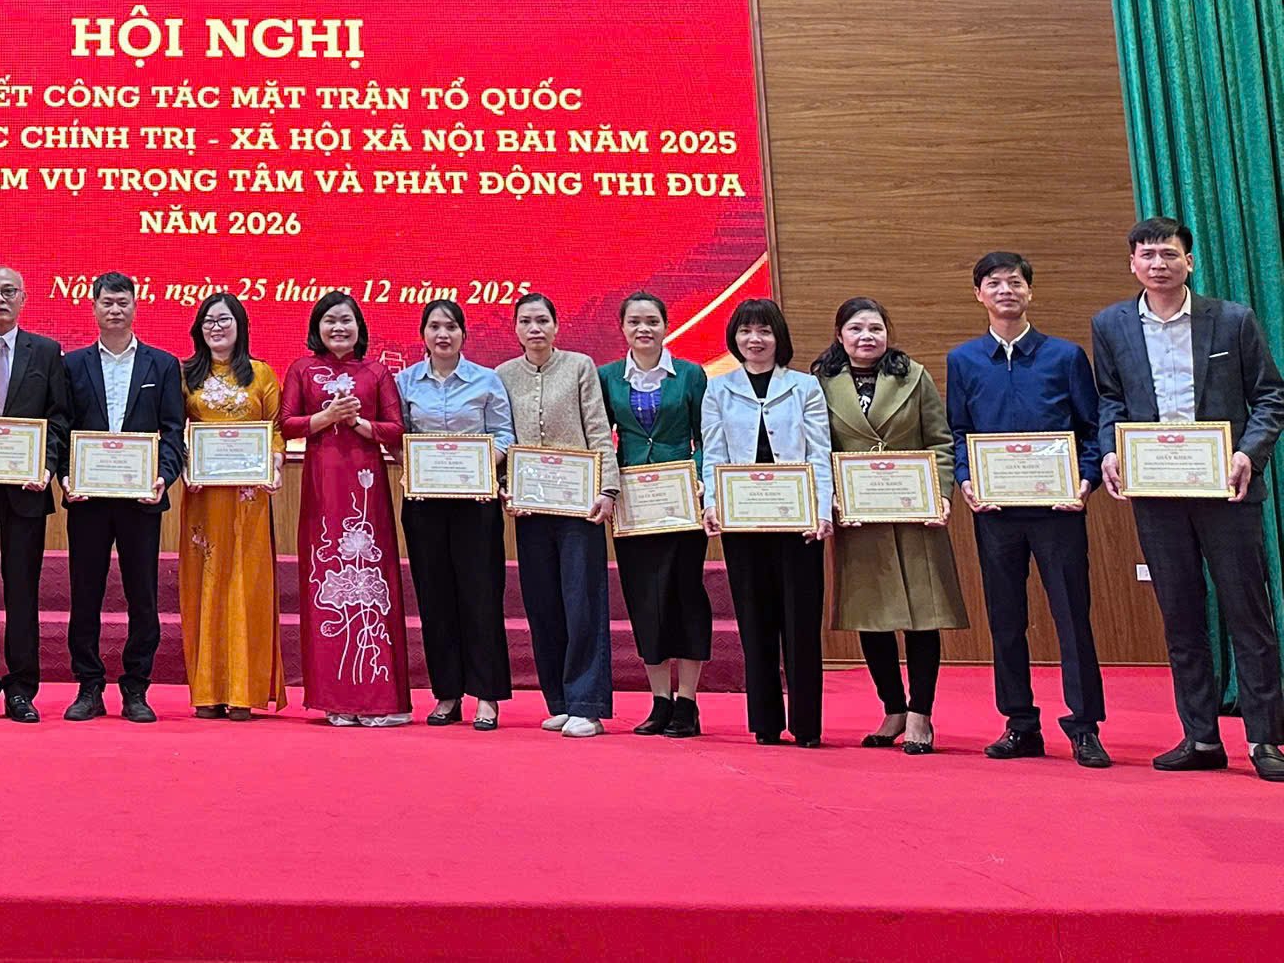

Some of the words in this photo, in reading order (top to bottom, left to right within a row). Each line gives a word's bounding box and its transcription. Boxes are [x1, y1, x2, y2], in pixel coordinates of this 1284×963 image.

[71, 4, 184, 68] HỘI
[205, 19, 365, 69] NGHỊ
[43, 78, 140, 108] CÔNG
[151, 79, 220, 109] TÁC
[231, 80, 306, 114] MẶT
[316, 80, 411, 115] TRẬN
[421, 77, 469, 111] TỔ
[481, 77, 583, 116] QUỐC
[21, 119, 130, 150] CHÍNH
[140, 127, 197, 156] TRỊ
[231, 123, 280, 151] XÃ
[289, 121, 353, 156] HỘI
[363, 124, 413, 152] XÃ
[422, 122, 485, 158] NỘI
[496, 123, 558, 153] BÀI
[567, 124, 650, 154] NĂM
[660, 130, 738, 155] 2025
[39, 168, 87, 197] VỤ
[97, 169, 218, 197] TRỌNG
[228, 162, 305, 193] TÂM
[315, 163, 365, 194] VÀ
[373, 164, 469, 195] PHÁT
[479, 164, 584, 200] ĐỘNG
[593, 173, 657, 197] THI
[667, 173, 747, 198] ĐUA
[139, 204, 218, 235] NĂM
[228, 212, 302, 236] 2026
[49, 275, 96, 305] Nội
[236, 278, 268, 302] 25
[362, 279, 392, 304] 12
[399, 281, 458, 306] năm
[466, 281, 531, 306] 2025
